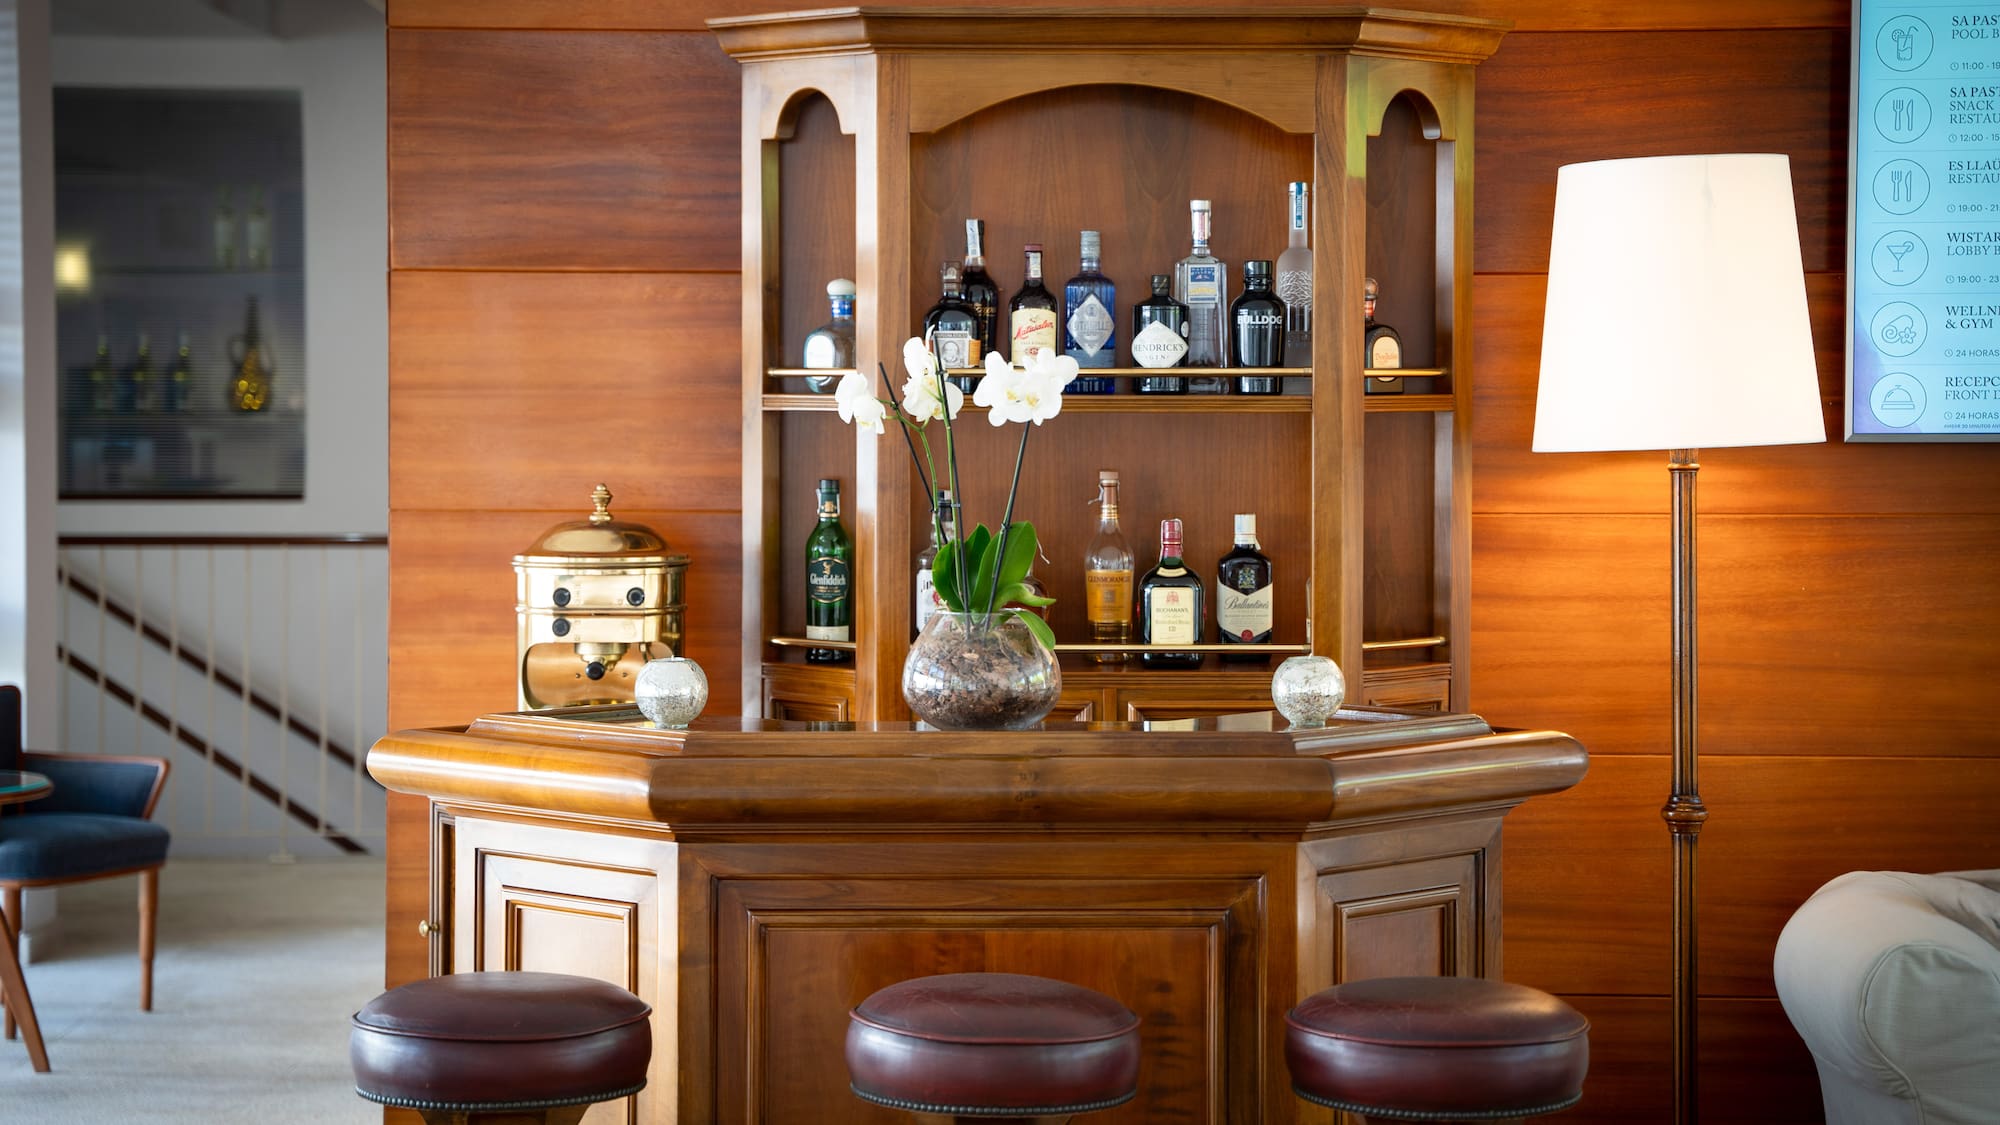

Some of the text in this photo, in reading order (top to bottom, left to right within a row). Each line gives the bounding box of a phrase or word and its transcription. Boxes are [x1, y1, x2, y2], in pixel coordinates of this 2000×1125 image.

[1952, 15, 2000, 26] SA PAS
[1952, 29, 1989, 39] POOL
[1950, 87, 1967, 98] SA
[1950, 100, 1994, 111] SNACK
[1960, 134, 1984, 142] 12:00
[1949, 161, 1964, 171] ES
[1949, 173, 2000, 184] RESTAU
[1947, 245, 1991, 256] LOBBY
[1958, 275, 1981, 283] 19:00
[1946, 305, 2000, 316] WELLN
[1237, 315, 1283, 325] BULLDOG
[1945, 318, 1993, 329] & GYM
[1134, 343, 1184, 352] HENDRICK'S
[1969, 349, 2000, 358] HORAS
[1945, 390, 1990, 400] FRONT
[1968, 411, 2000, 420] HORAS
[810, 572, 847, 586] Glenfiddich
